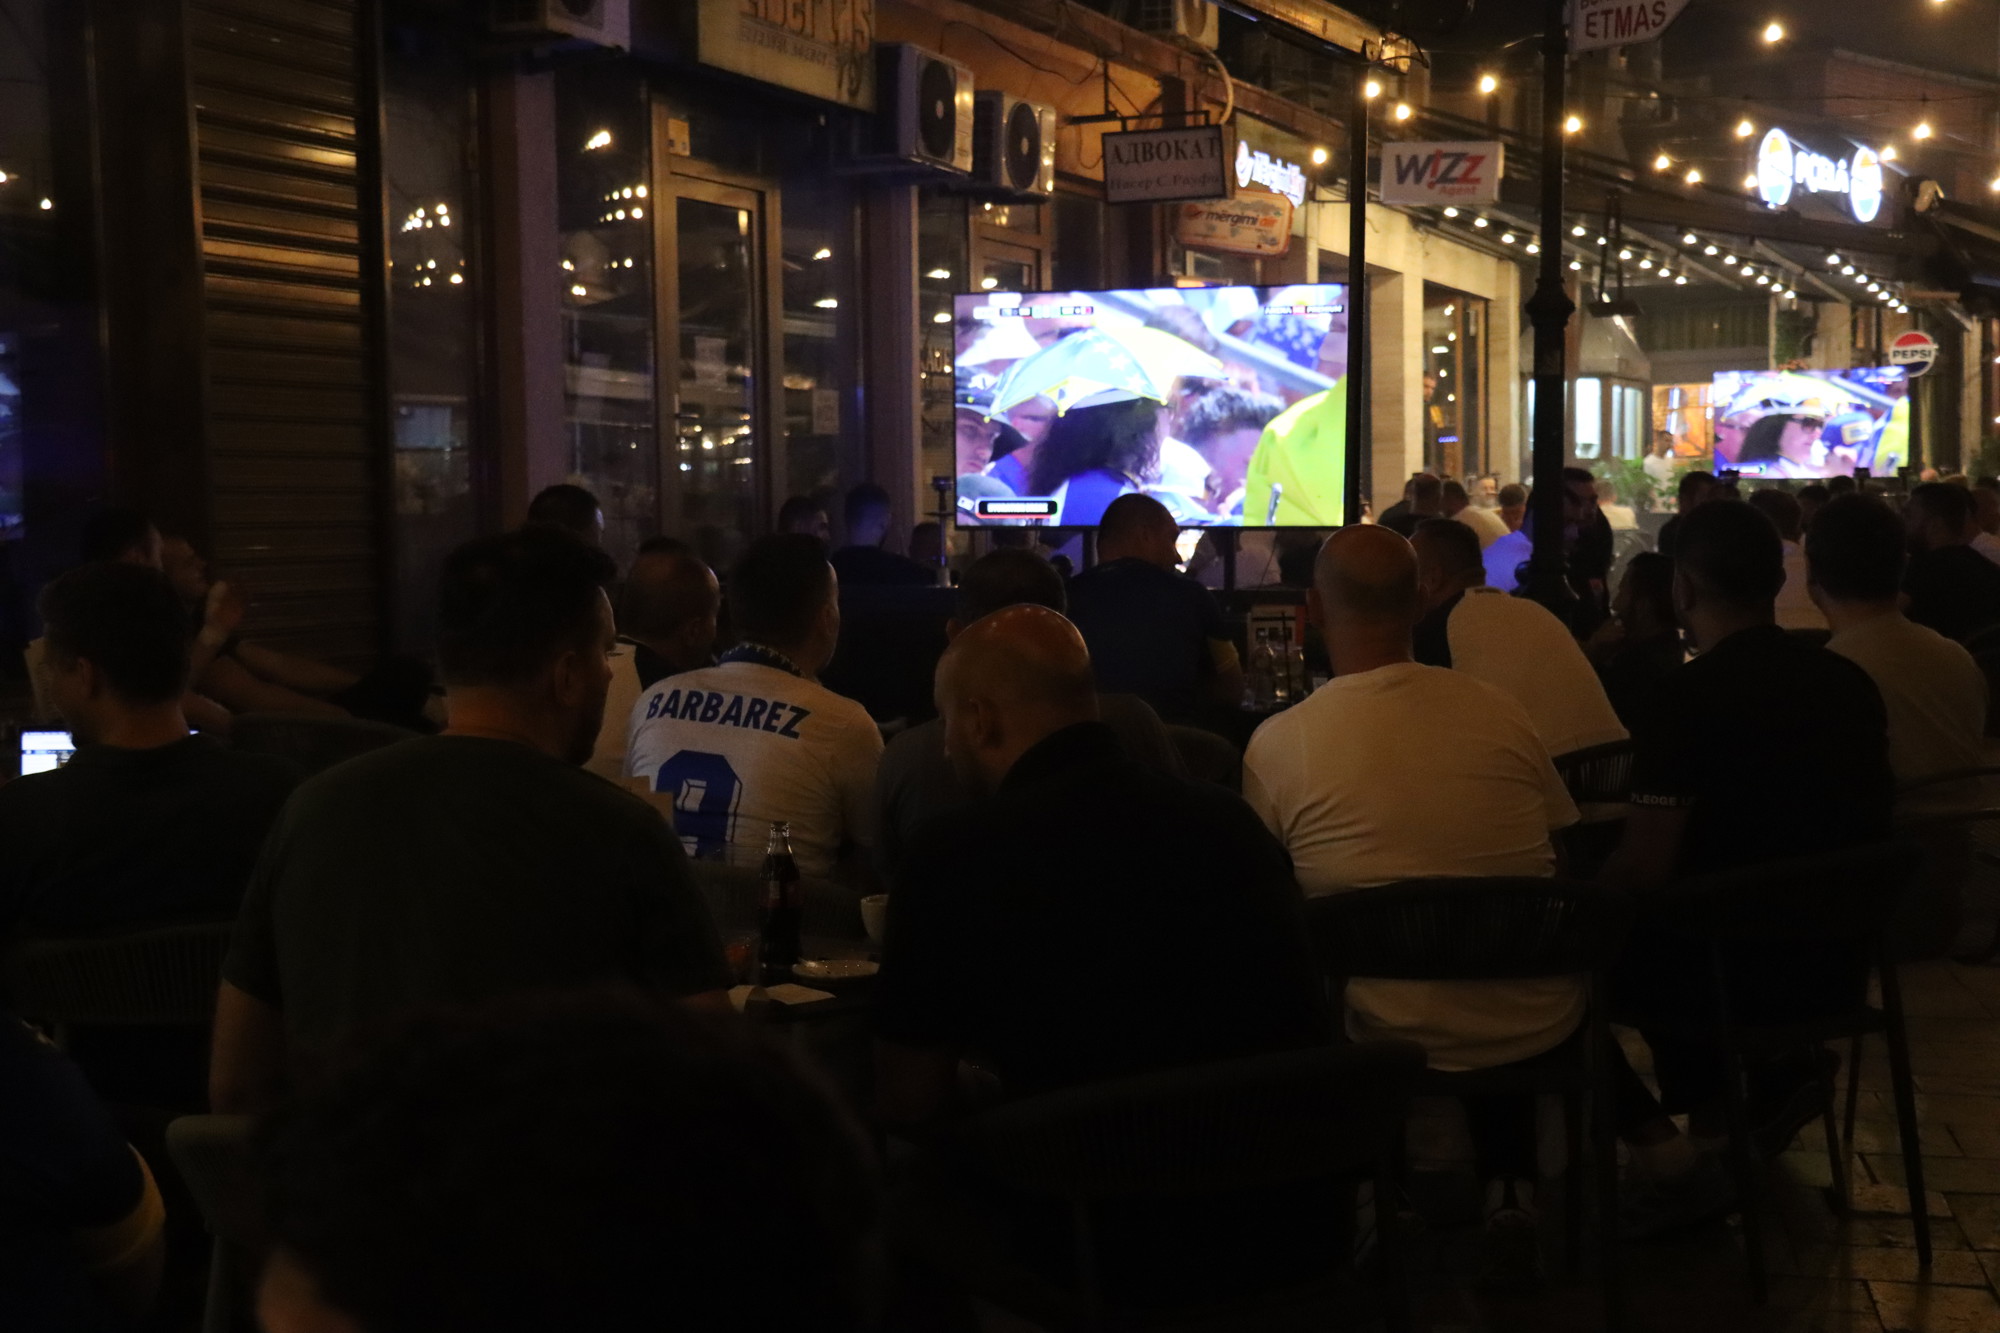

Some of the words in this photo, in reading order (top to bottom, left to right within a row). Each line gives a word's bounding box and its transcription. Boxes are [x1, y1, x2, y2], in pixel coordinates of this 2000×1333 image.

[1585, 1, 1666, 39] ETMAS
[1110, 137, 1219, 166] АДВОКАТ
[1893, 350, 1932, 359] PEPSI
[646, 689, 811, 739] BARBAREZ
[656, 749, 743, 859] 9
